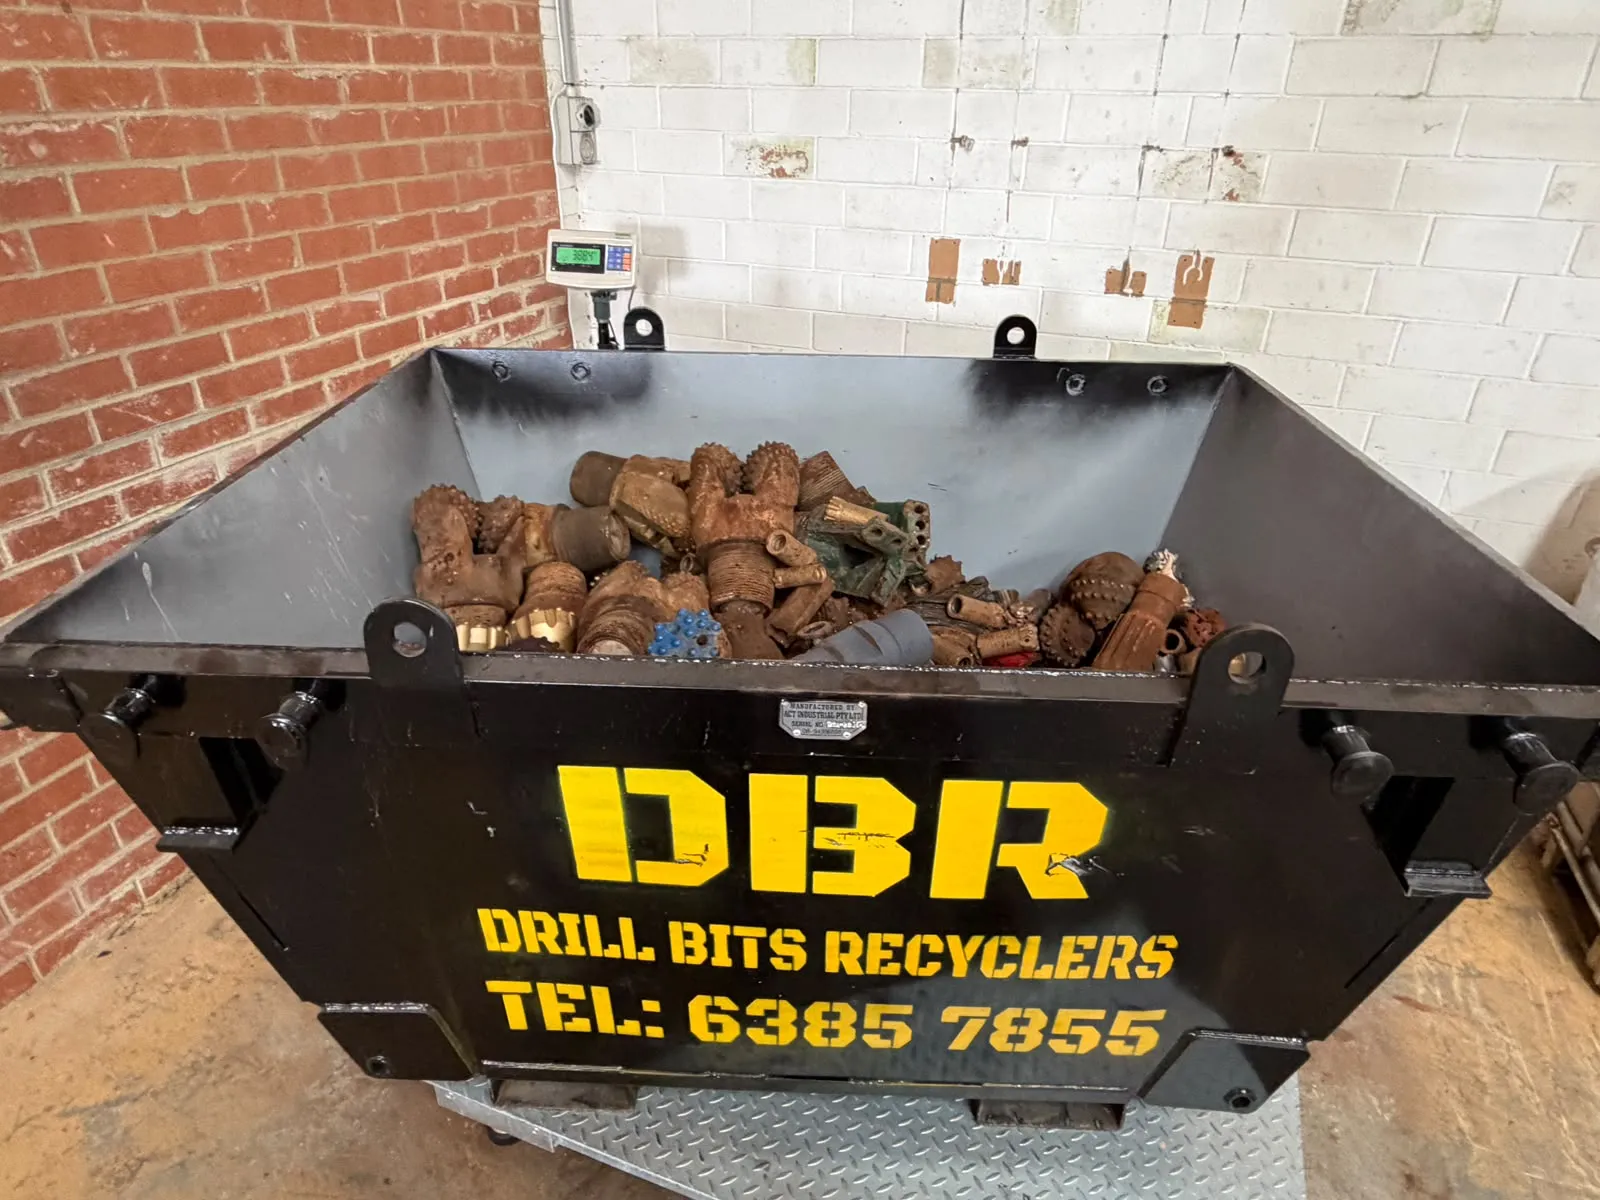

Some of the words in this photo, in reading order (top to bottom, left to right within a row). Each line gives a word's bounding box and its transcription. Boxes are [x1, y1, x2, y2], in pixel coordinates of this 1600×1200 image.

[784, 710, 796, 718] ACT
[797, 710, 835, 719] INDUSTRIAL
[789, 703, 843, 711] MANUFACTURED
[846, 703, 856, 711] BY
[558, 765, 1109, 899] DBR
[477, 908, 655, 961] DRILL
[669, 921, 807, 971] BITS
[825, 931, 1178, 980] RECYCLERS
[485, 980, 665, 1038] TEL:
[688, 995, 913, 1049] 6385
[942, 1007, 1167, 1056] 7855
